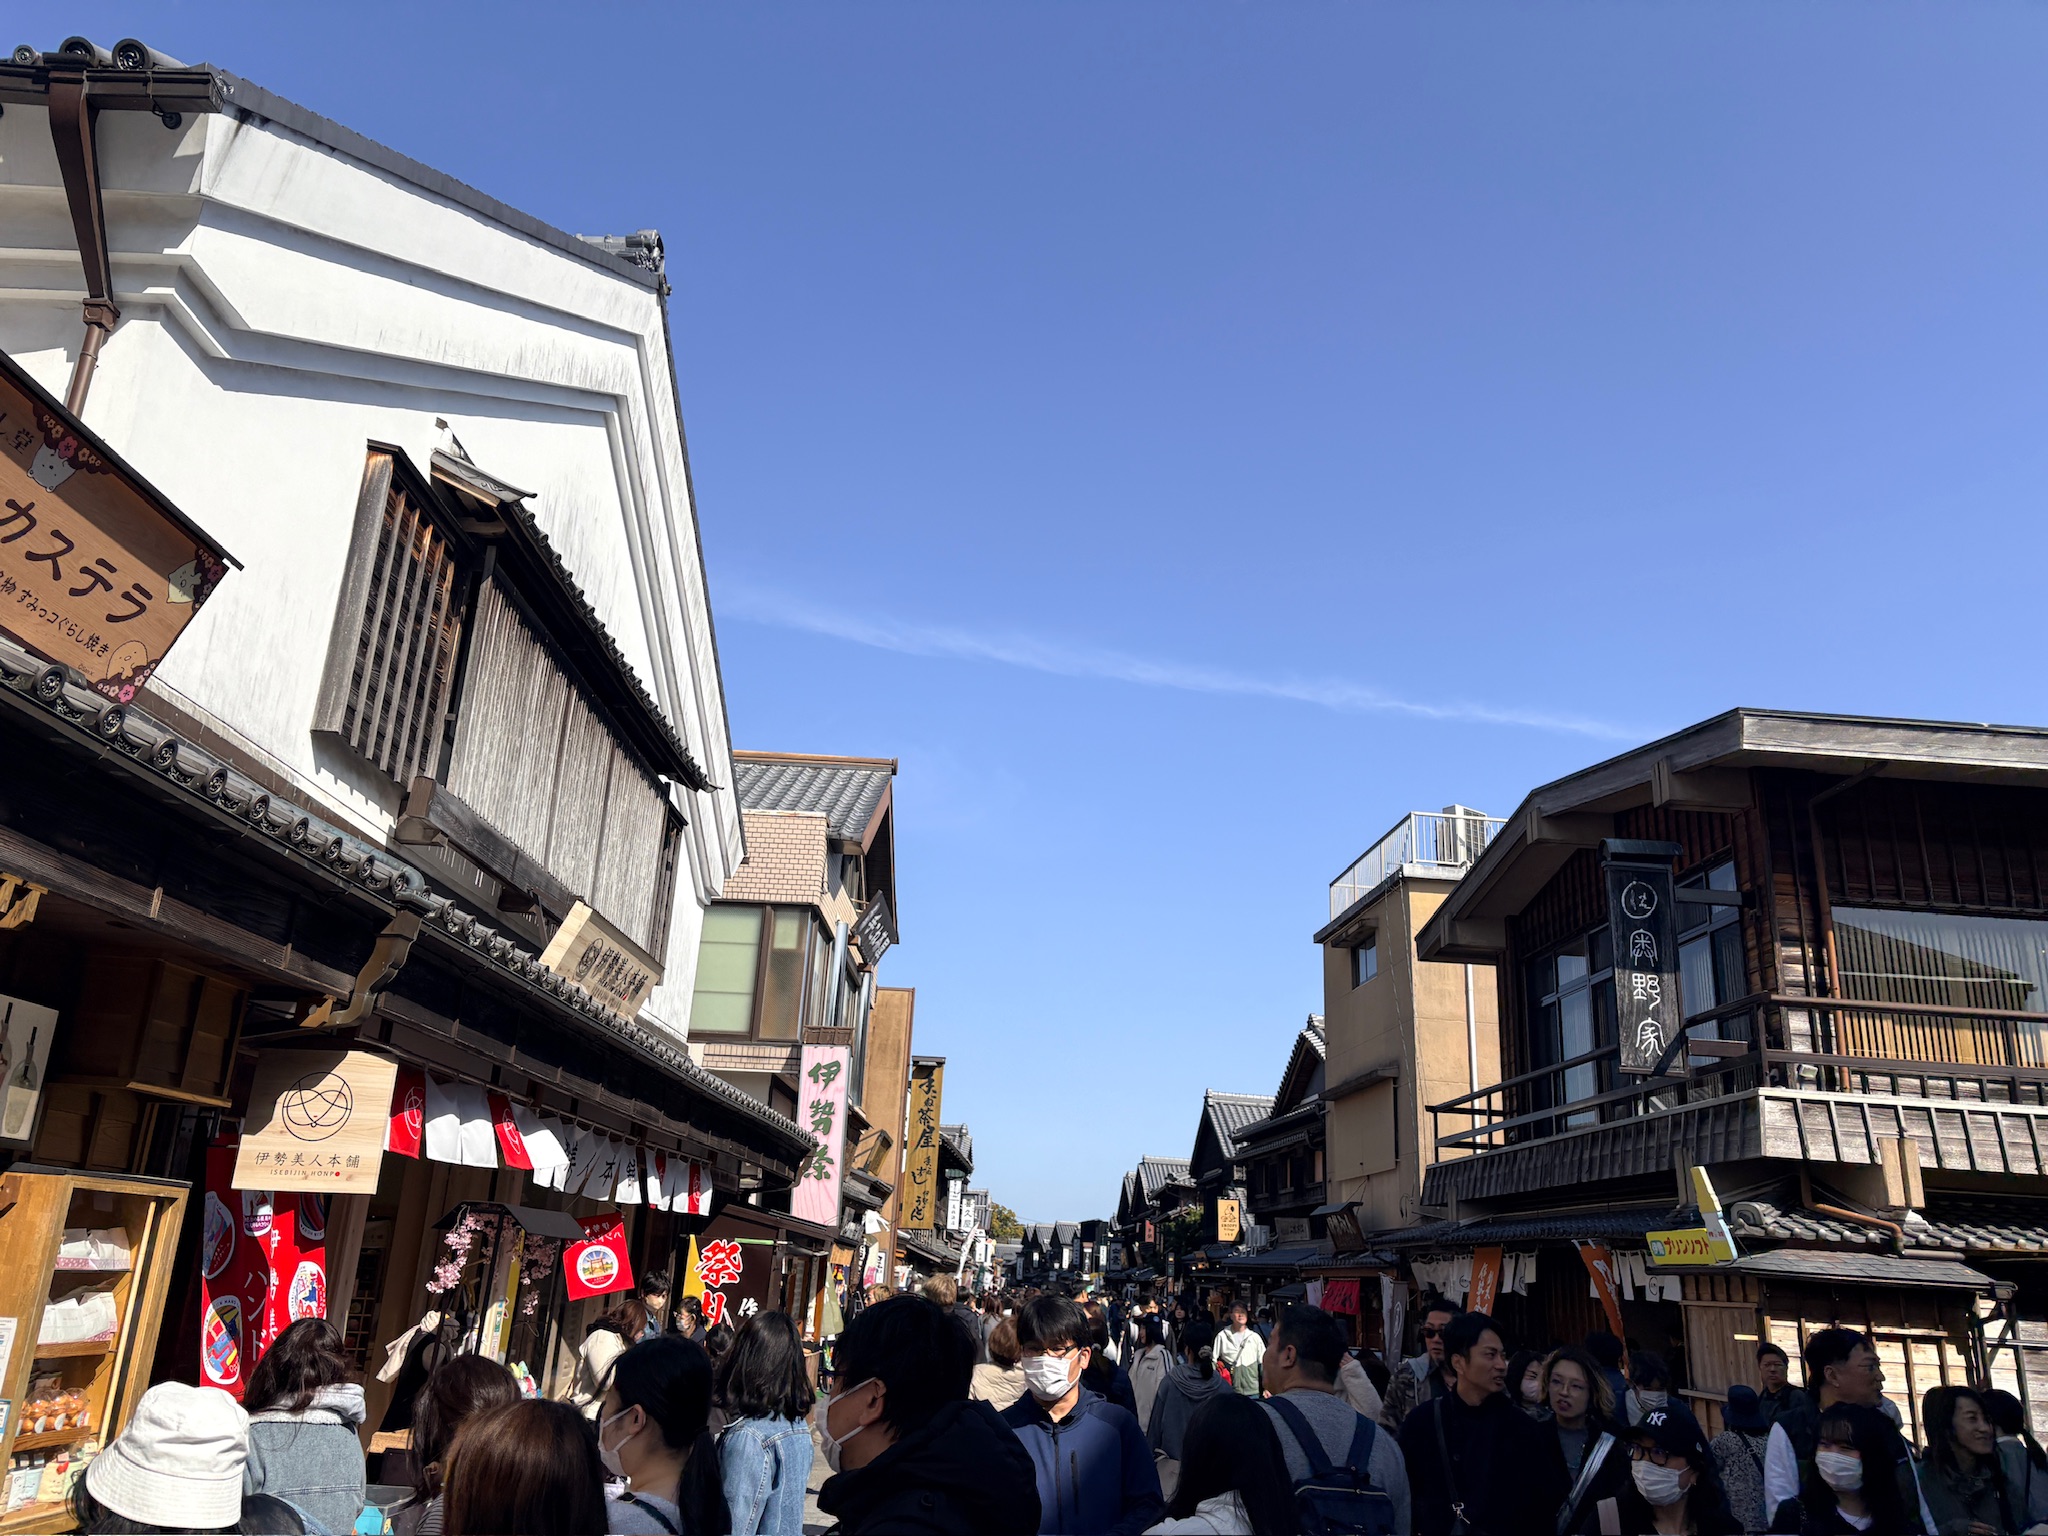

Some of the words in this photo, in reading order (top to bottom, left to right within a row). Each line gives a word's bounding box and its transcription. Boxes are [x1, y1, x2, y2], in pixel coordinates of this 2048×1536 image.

[0, 498, 153, 623] カステラ
[0, 571, 17, 595] 物
[16, 589, 110, 658] すみっコぐらし焼き
[255, 1152, 361, 1168] 伊勢美人本舗
[803, 1060, 841, 1181] 伊勢茶
[1663, 1237, 1709, 1255] プリンソフト
